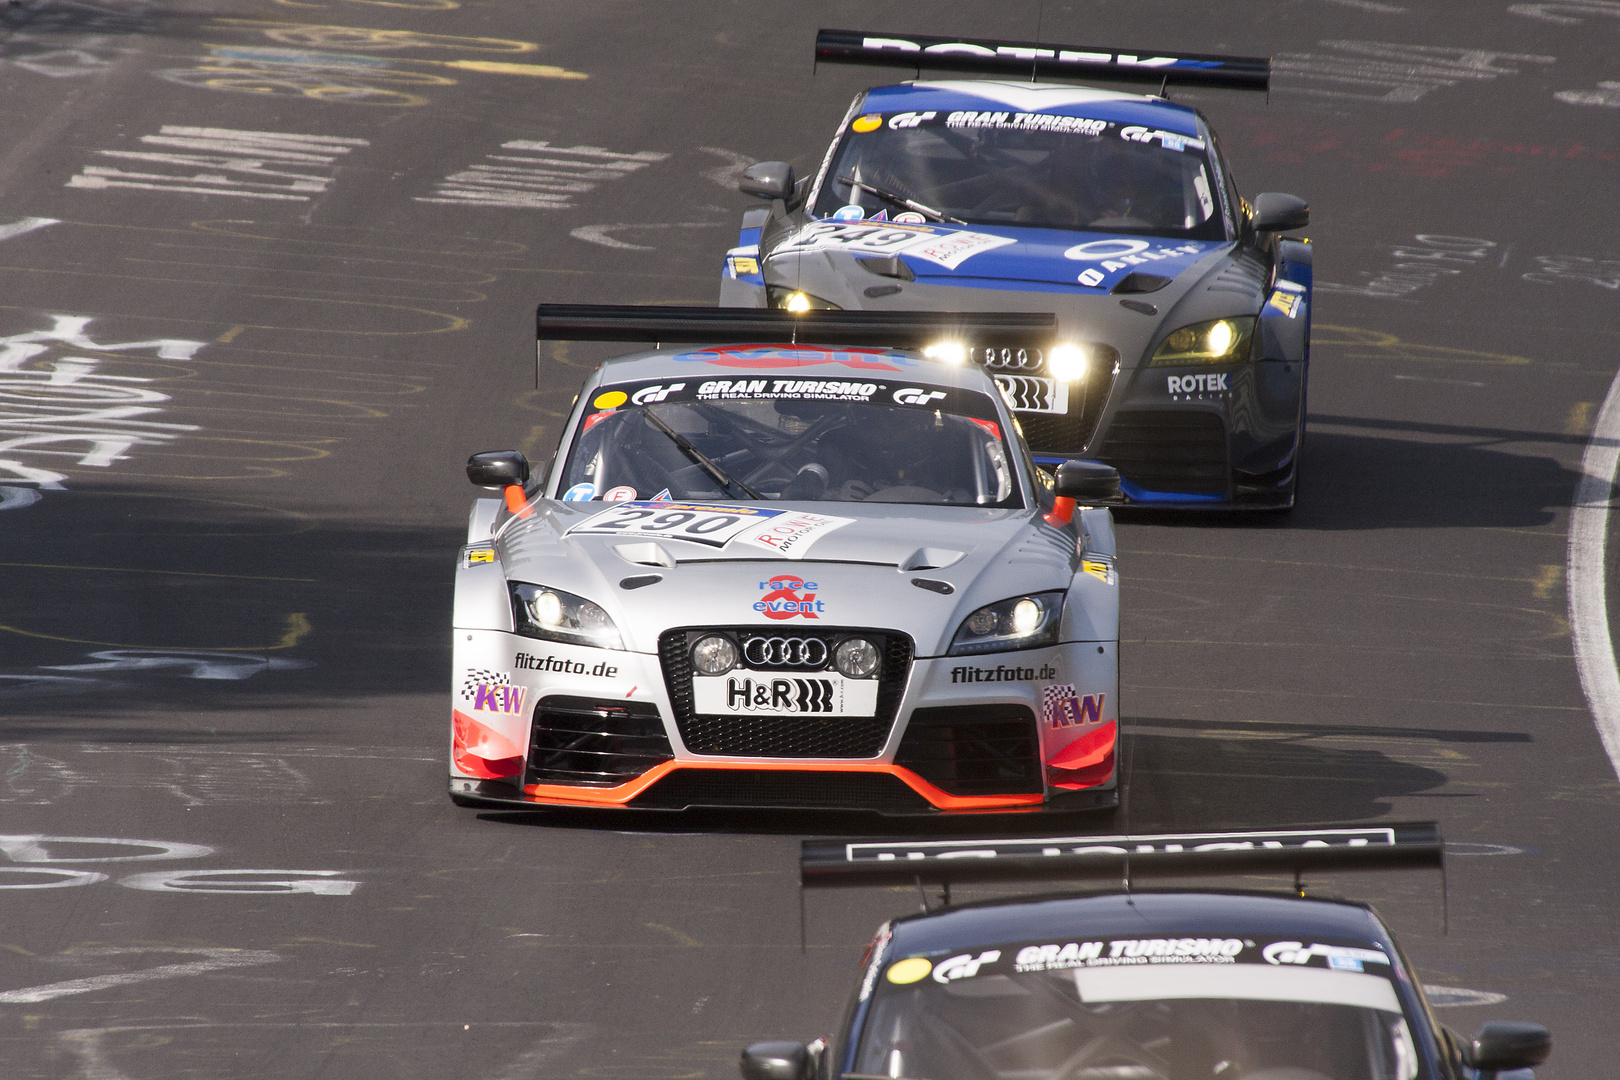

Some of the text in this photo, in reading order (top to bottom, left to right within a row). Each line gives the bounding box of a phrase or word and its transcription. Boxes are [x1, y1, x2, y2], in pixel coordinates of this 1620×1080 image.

[946, 111, 1107, 132] GRAN TURISMO
[793, 225, 917, 247] 249
[924, 234, 989, 258] ROWE
[1077, 245, 1200, 287] OAKLEY
[631, 383, 686, 405] GT
[697, 380, 877, 396] GRAN TURISMO
[1167, 373, 1228, 394] ROTEK
[803, 392, 870, 402] SIMULATOR
[892, 388, 947, 405] GT
[593, 510, 741, 536] 290
[758, 515, 824, 547] ROWE
[778, 526, 813, 552] MOTOR
[759, 581, 819, 591] race
[752, 600, 826, 613] event
[515, 652, 618, 679] flitzfoto.de
[951, 664, 1056, 684] flitzfoto.de
[473, 683, 527, 716] KW
[727, 677, 798, 712] H&R
[1051, 693, 1106, 730] KW
[1015, 938, 1244, 965] GRAN TURISMO
[932, 950, 1001, 984] GT
[1013, 955, 1236, 973] THE REAL DRIVING SIMULATOR
